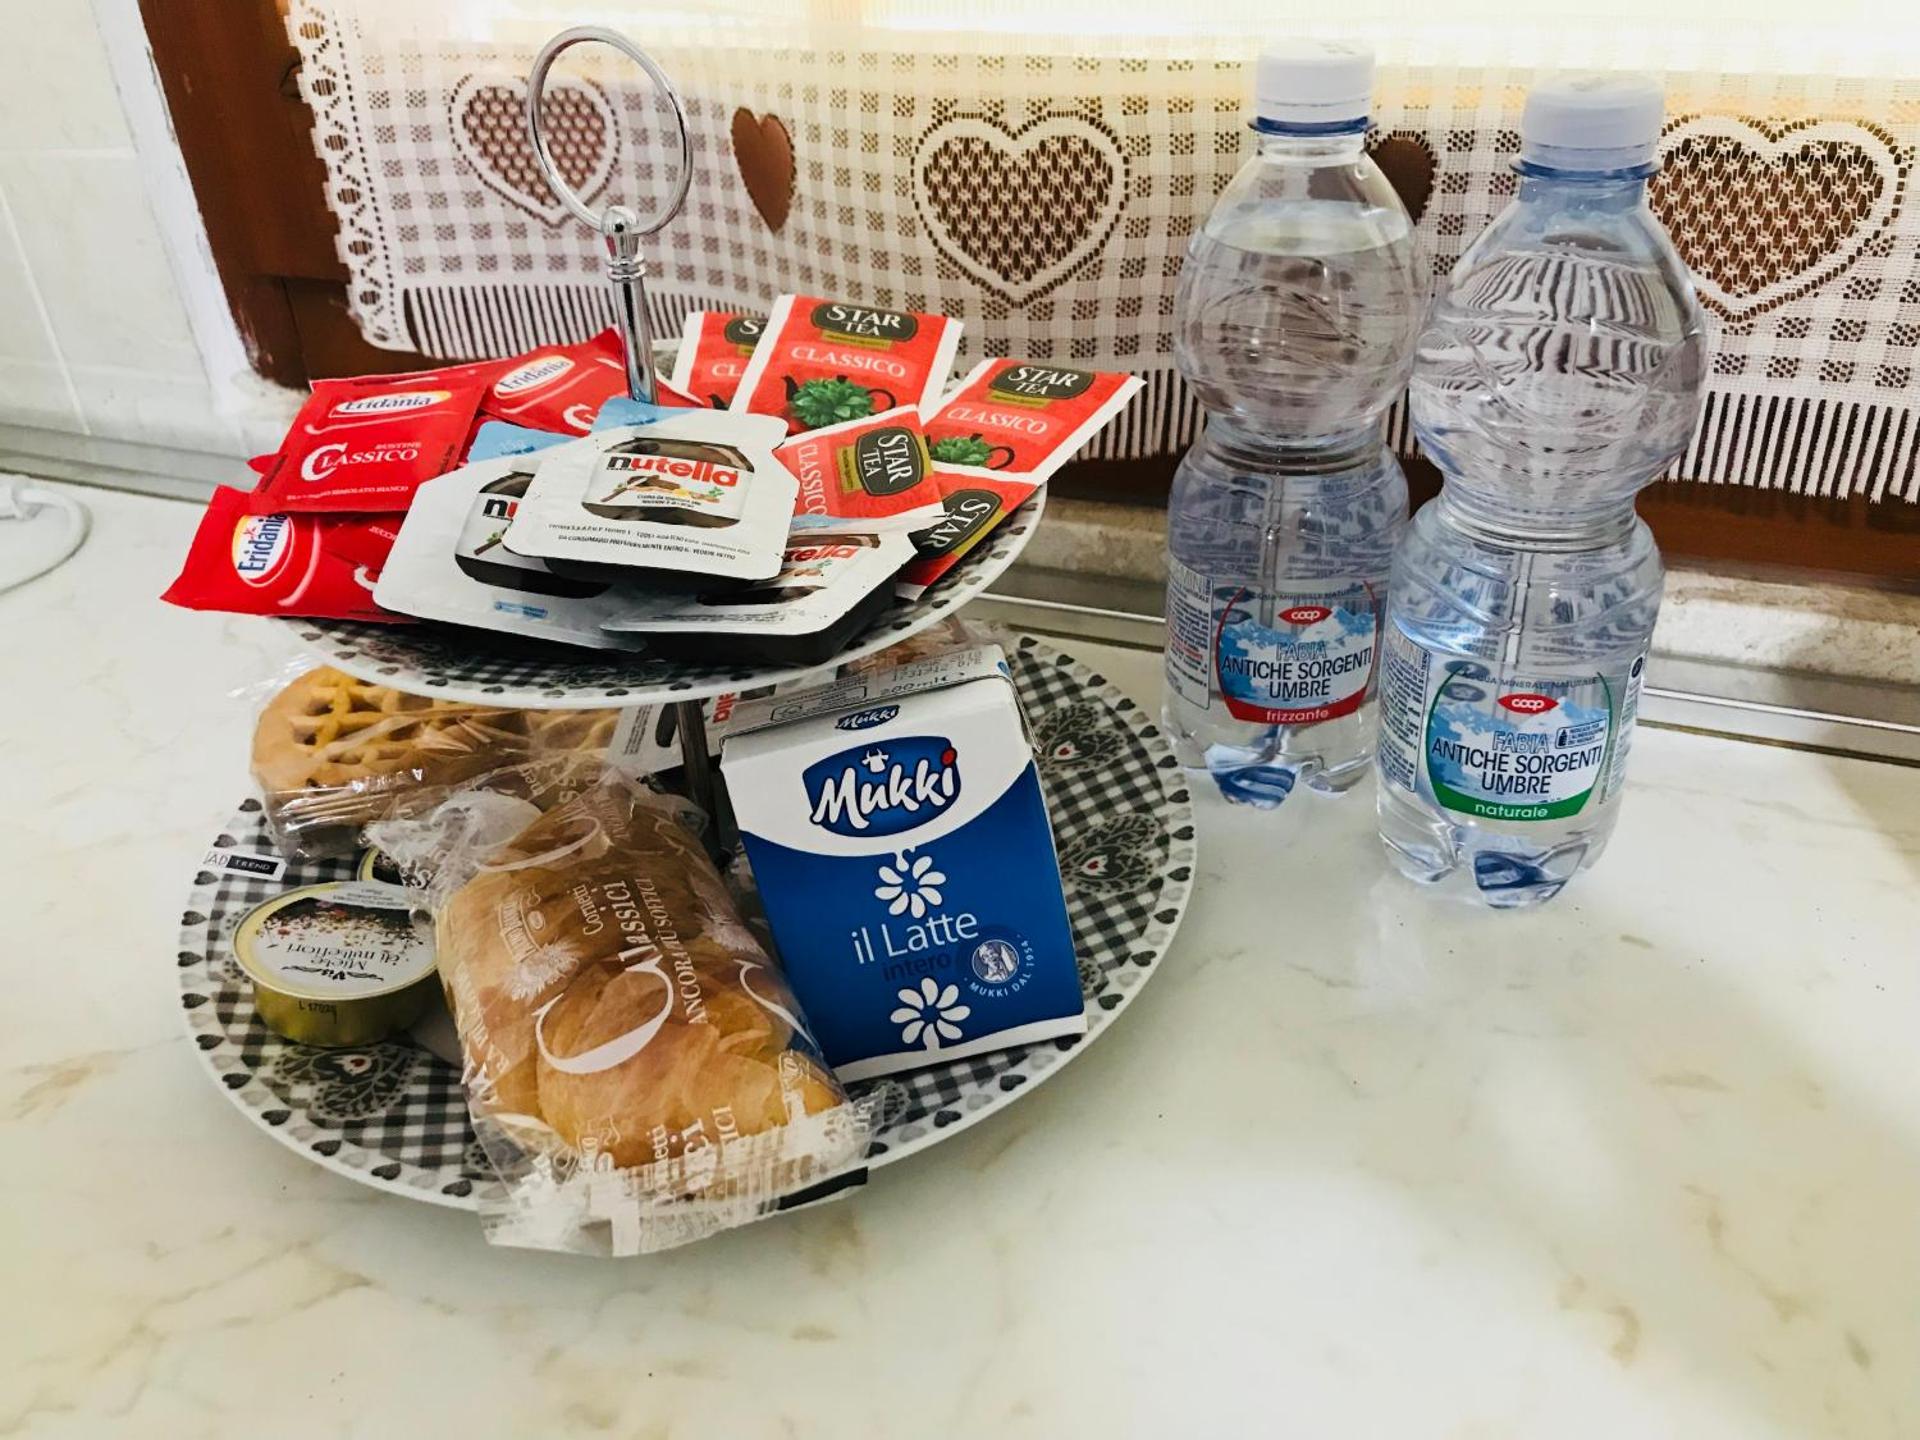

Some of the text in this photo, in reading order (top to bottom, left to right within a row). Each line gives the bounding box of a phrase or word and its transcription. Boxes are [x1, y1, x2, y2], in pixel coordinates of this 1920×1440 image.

[825, 304, 902, 329] STAR
[840, 321, 881, 337] TEA
[501, 360, 570, 390] Eridania
[790, 346, 906, 378] CLASSICO
[1007, 366, 1080, 388] STAR
[1014, 381, 1049, 396] TEA
[946, 406, 1049, 435] CLASSICO
[301, 442, 419, 482] CLASSICO
[608, 455, 740, 488] nutella
[862, 447, 883, 478] TEA
[877, 433, 914, 485] STAR
[918, 498, 993, 549] STAR
[237, 512, 288, 572] Eridania
[1290, 610, 1322, 625] coop
[1220, 646, 1372, 681] ANTICHE SORGENTI
[1275, 641, 1328, 662] FABIA
[1268, 678, 1331, 699] UMBRE
[838, 706, 898, 730] Mukki
[1265, 708, 1330, 723] frizzante
[1511, 698, 1545, 712] coop
[1431, 737, 1602, 775] ANTICHE SORGENTI
[1491, 730, 1550, 755] FABIA
[810, 746, 958, 830] Mukki
[1481, 771, 1553, 795] UMBRE
[1474, 801, 1549, 819] naturale
[234, 858, 271, 870] TREND
[567, 884, 604, 936] Cornetti
[635, 876, 674, 928] SOFFICI
[851, 911, 979, 965] il Latte
[531, 879, 676, 1075] Classici
[881, 949, 951, 982] intero
[675, 950, 710, 1025] ANCORA
[968, 981, 1009, 998] MUKKI
[1011, 972, 1033, 993] DAL
